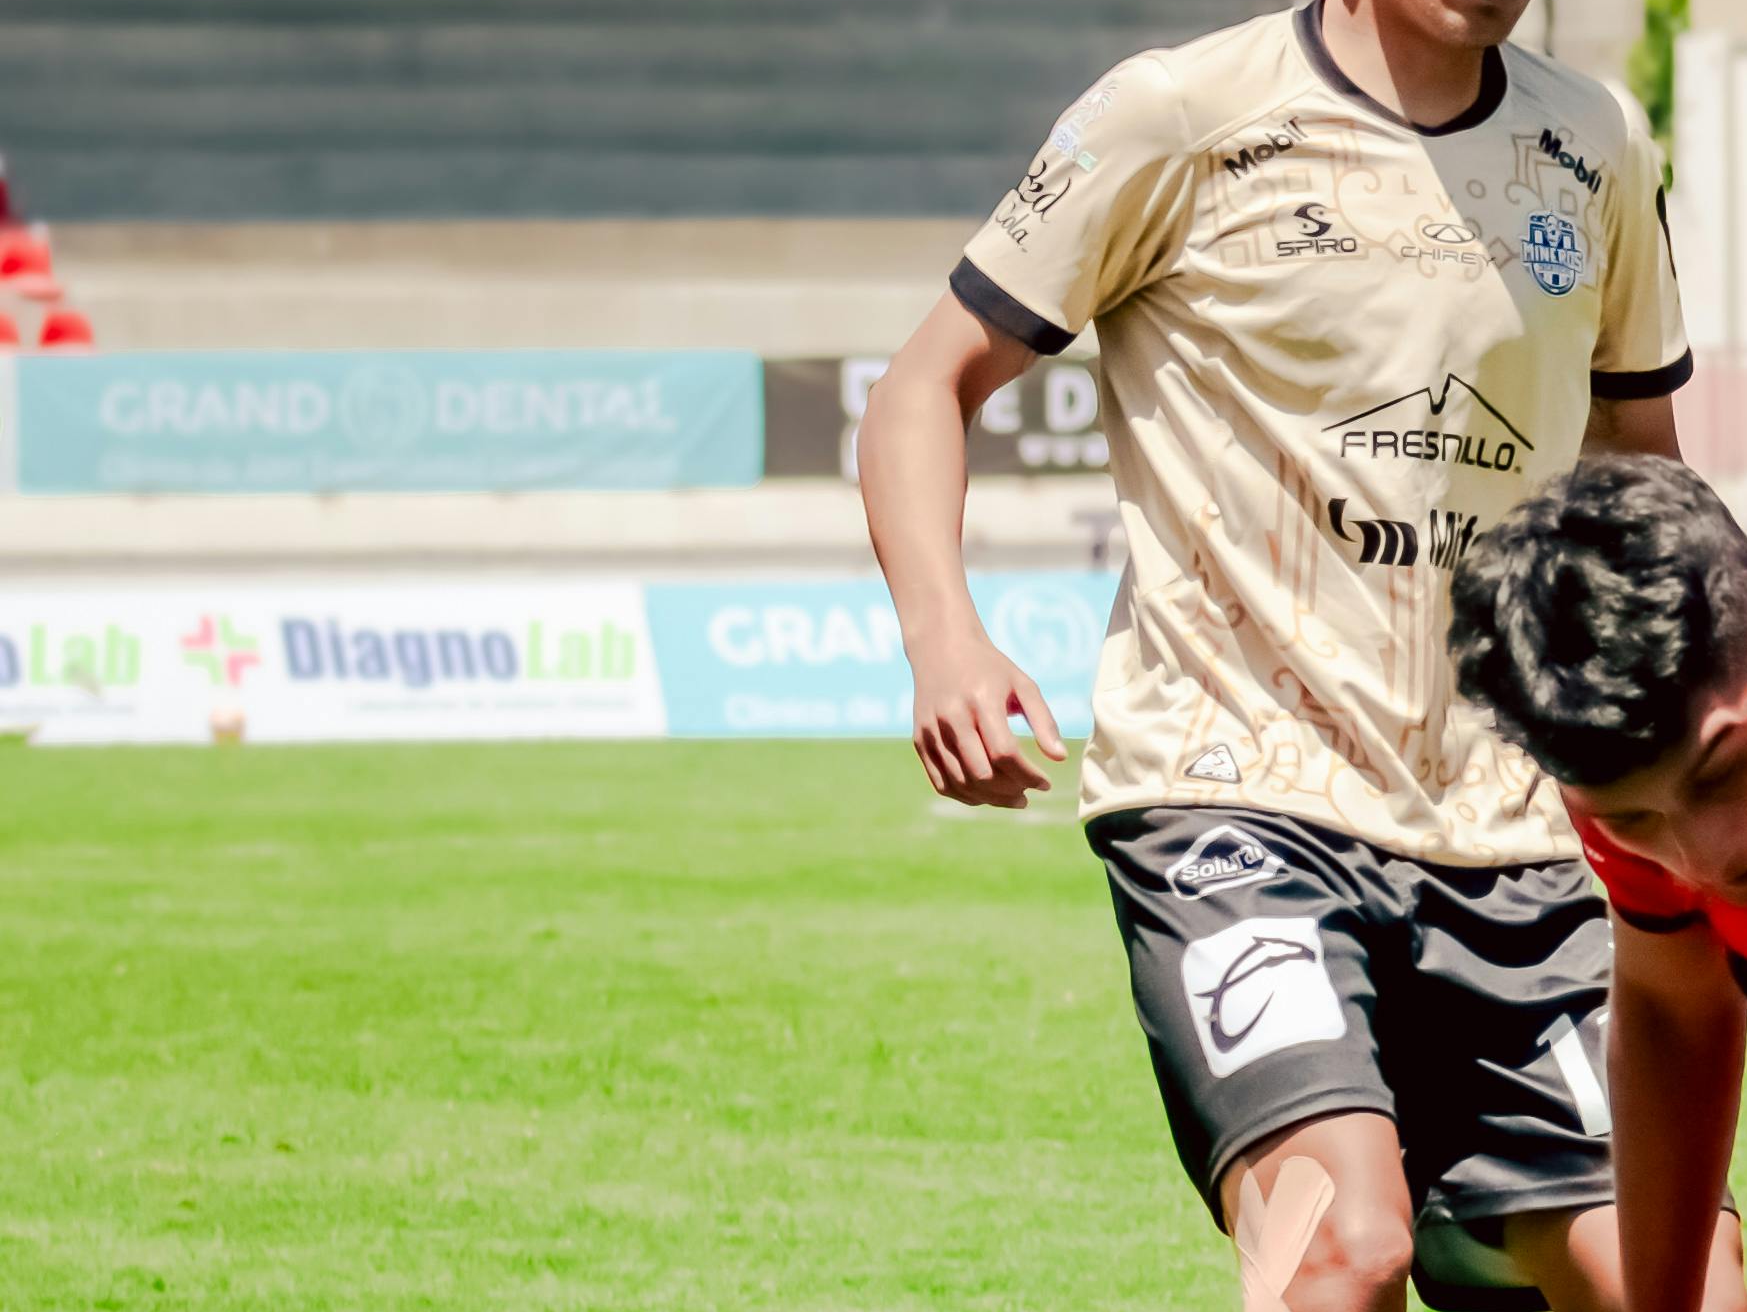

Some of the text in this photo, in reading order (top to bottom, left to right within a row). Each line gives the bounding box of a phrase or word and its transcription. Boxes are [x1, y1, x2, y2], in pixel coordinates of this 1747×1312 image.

[1223, 116, 1309, 180] Mobil
[1538, 127, 1602, 195] Mobil
[1276, 237, 1357, 257] SPIRO
[1401, 245, 1496, 266] CHIREY
[1521, 241, 1584, 273] MINEROS
[100, 378, 677, 434] GRAND DENTAL
[281, 615, 637, 689] DiagnoLab
